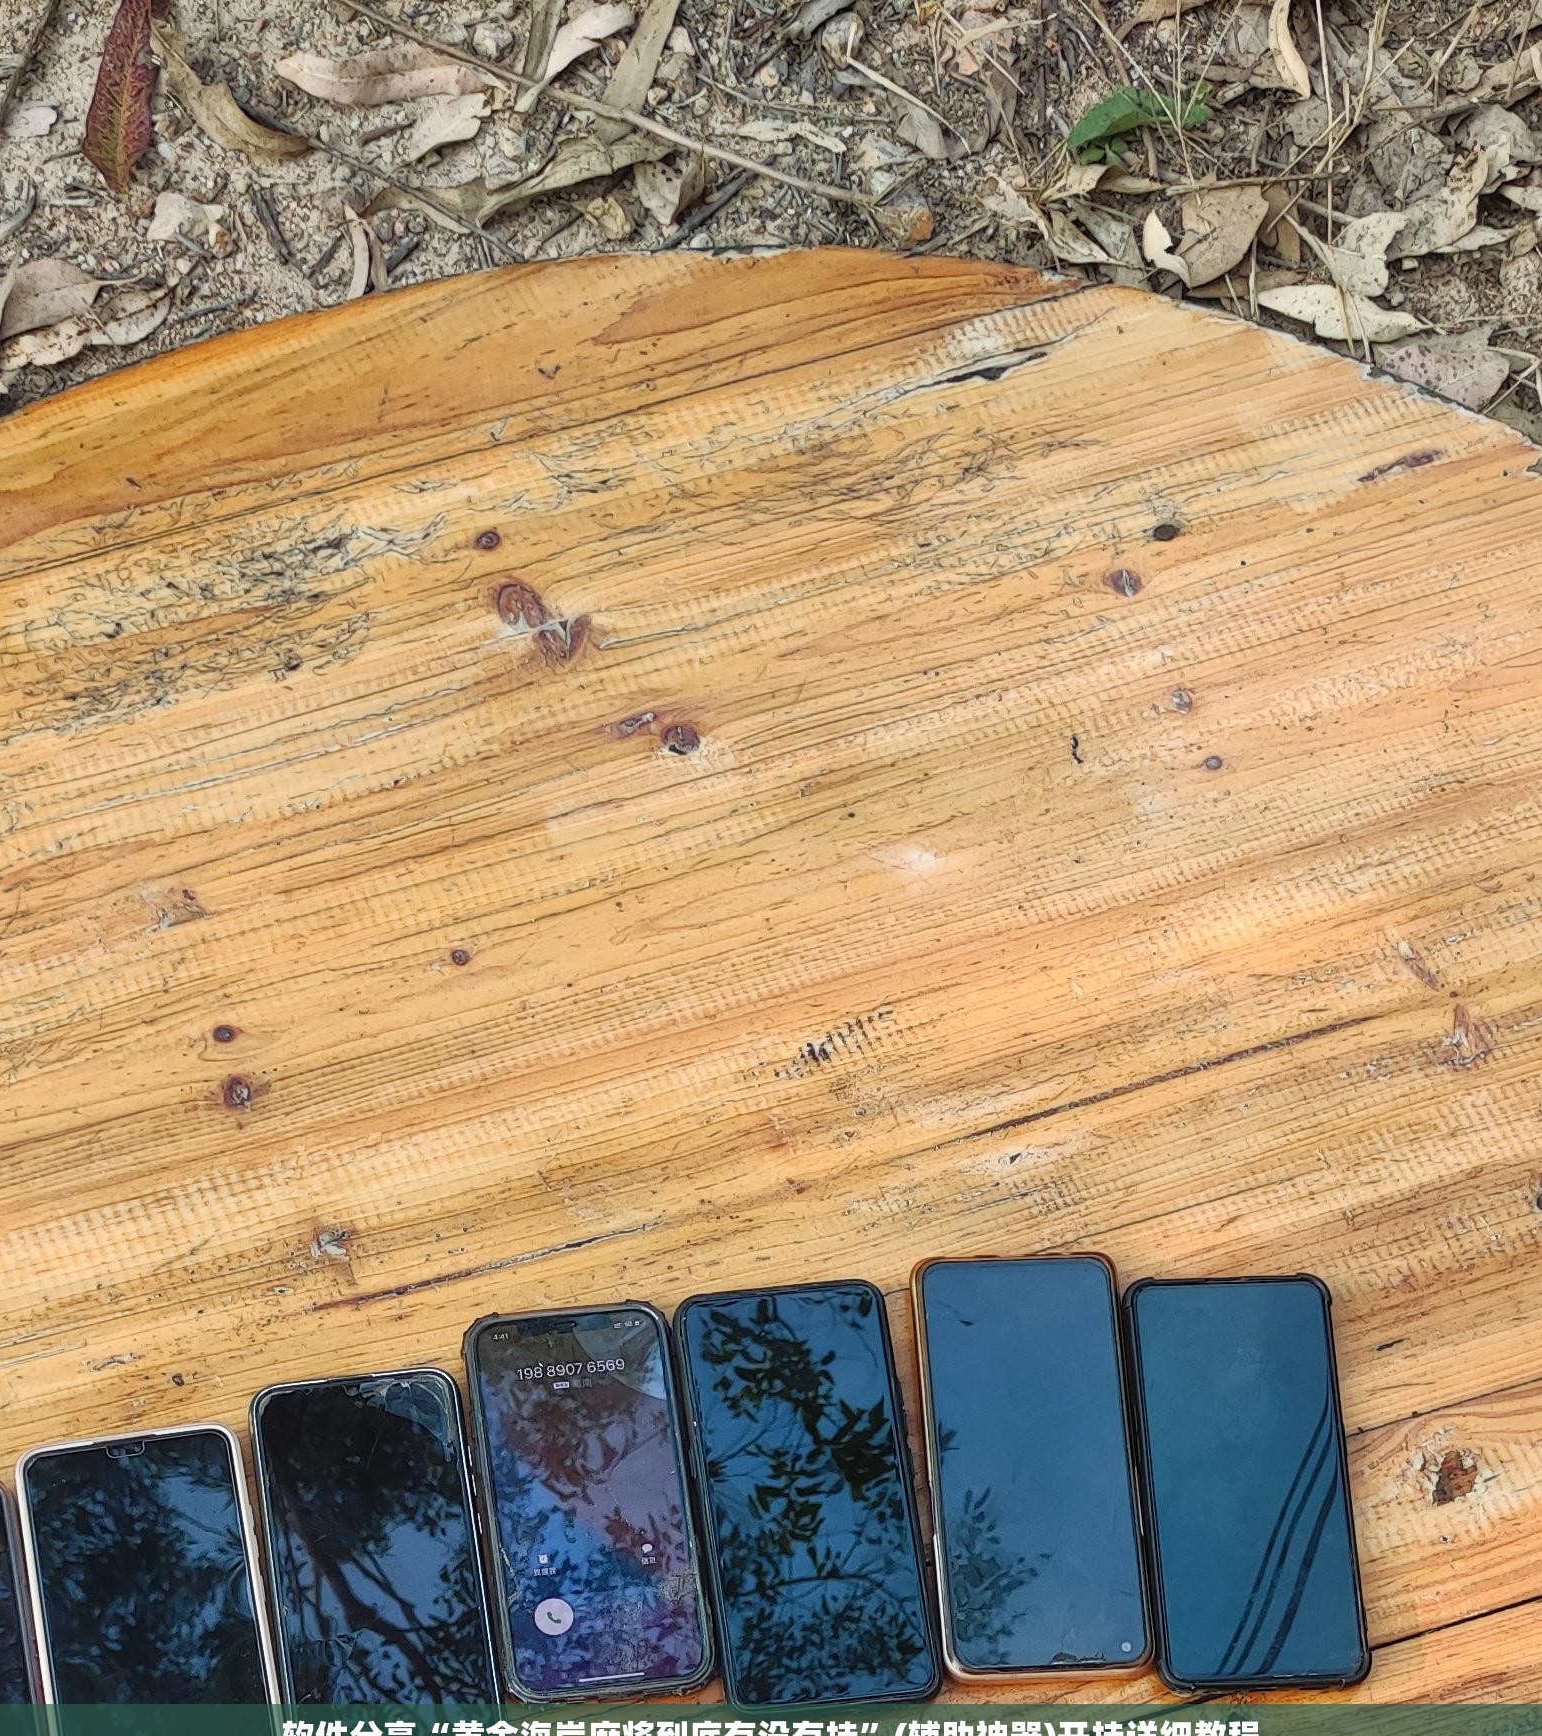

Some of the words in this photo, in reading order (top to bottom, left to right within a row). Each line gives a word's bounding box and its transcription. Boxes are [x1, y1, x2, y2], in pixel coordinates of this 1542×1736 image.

[517, 1365, 543, 1381] 198
[547, 1362, 583, 1377] 8907
[587, 1358, 625, 1373] 6569
